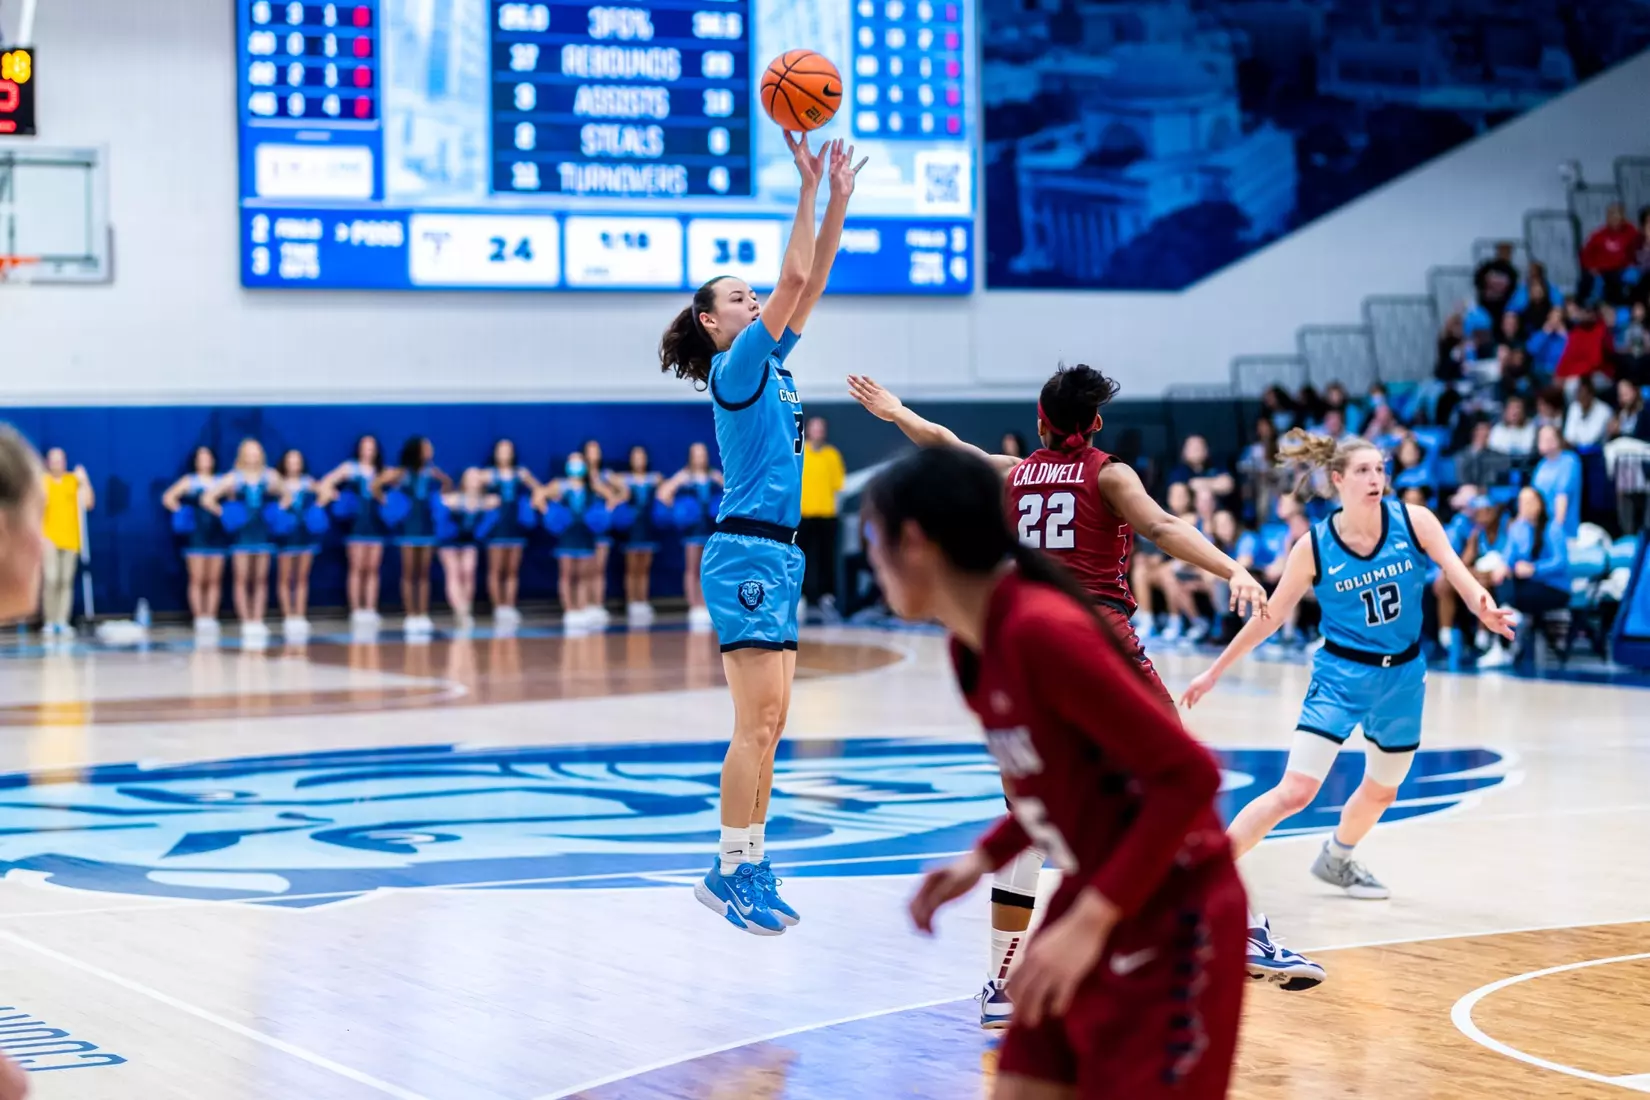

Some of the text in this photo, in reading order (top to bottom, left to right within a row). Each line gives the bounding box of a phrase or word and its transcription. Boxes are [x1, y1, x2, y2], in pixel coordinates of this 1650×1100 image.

[488, 236, 534, 263] 24
[1013, 462, 1084, 486] CALDWELL
[1018, 492, 1075, 549] 22
[1335, 559, 1413, 592] COLUMBIA
[1360, 582, 1401, 627] 12
[1381, 655, 1391, 667] C
